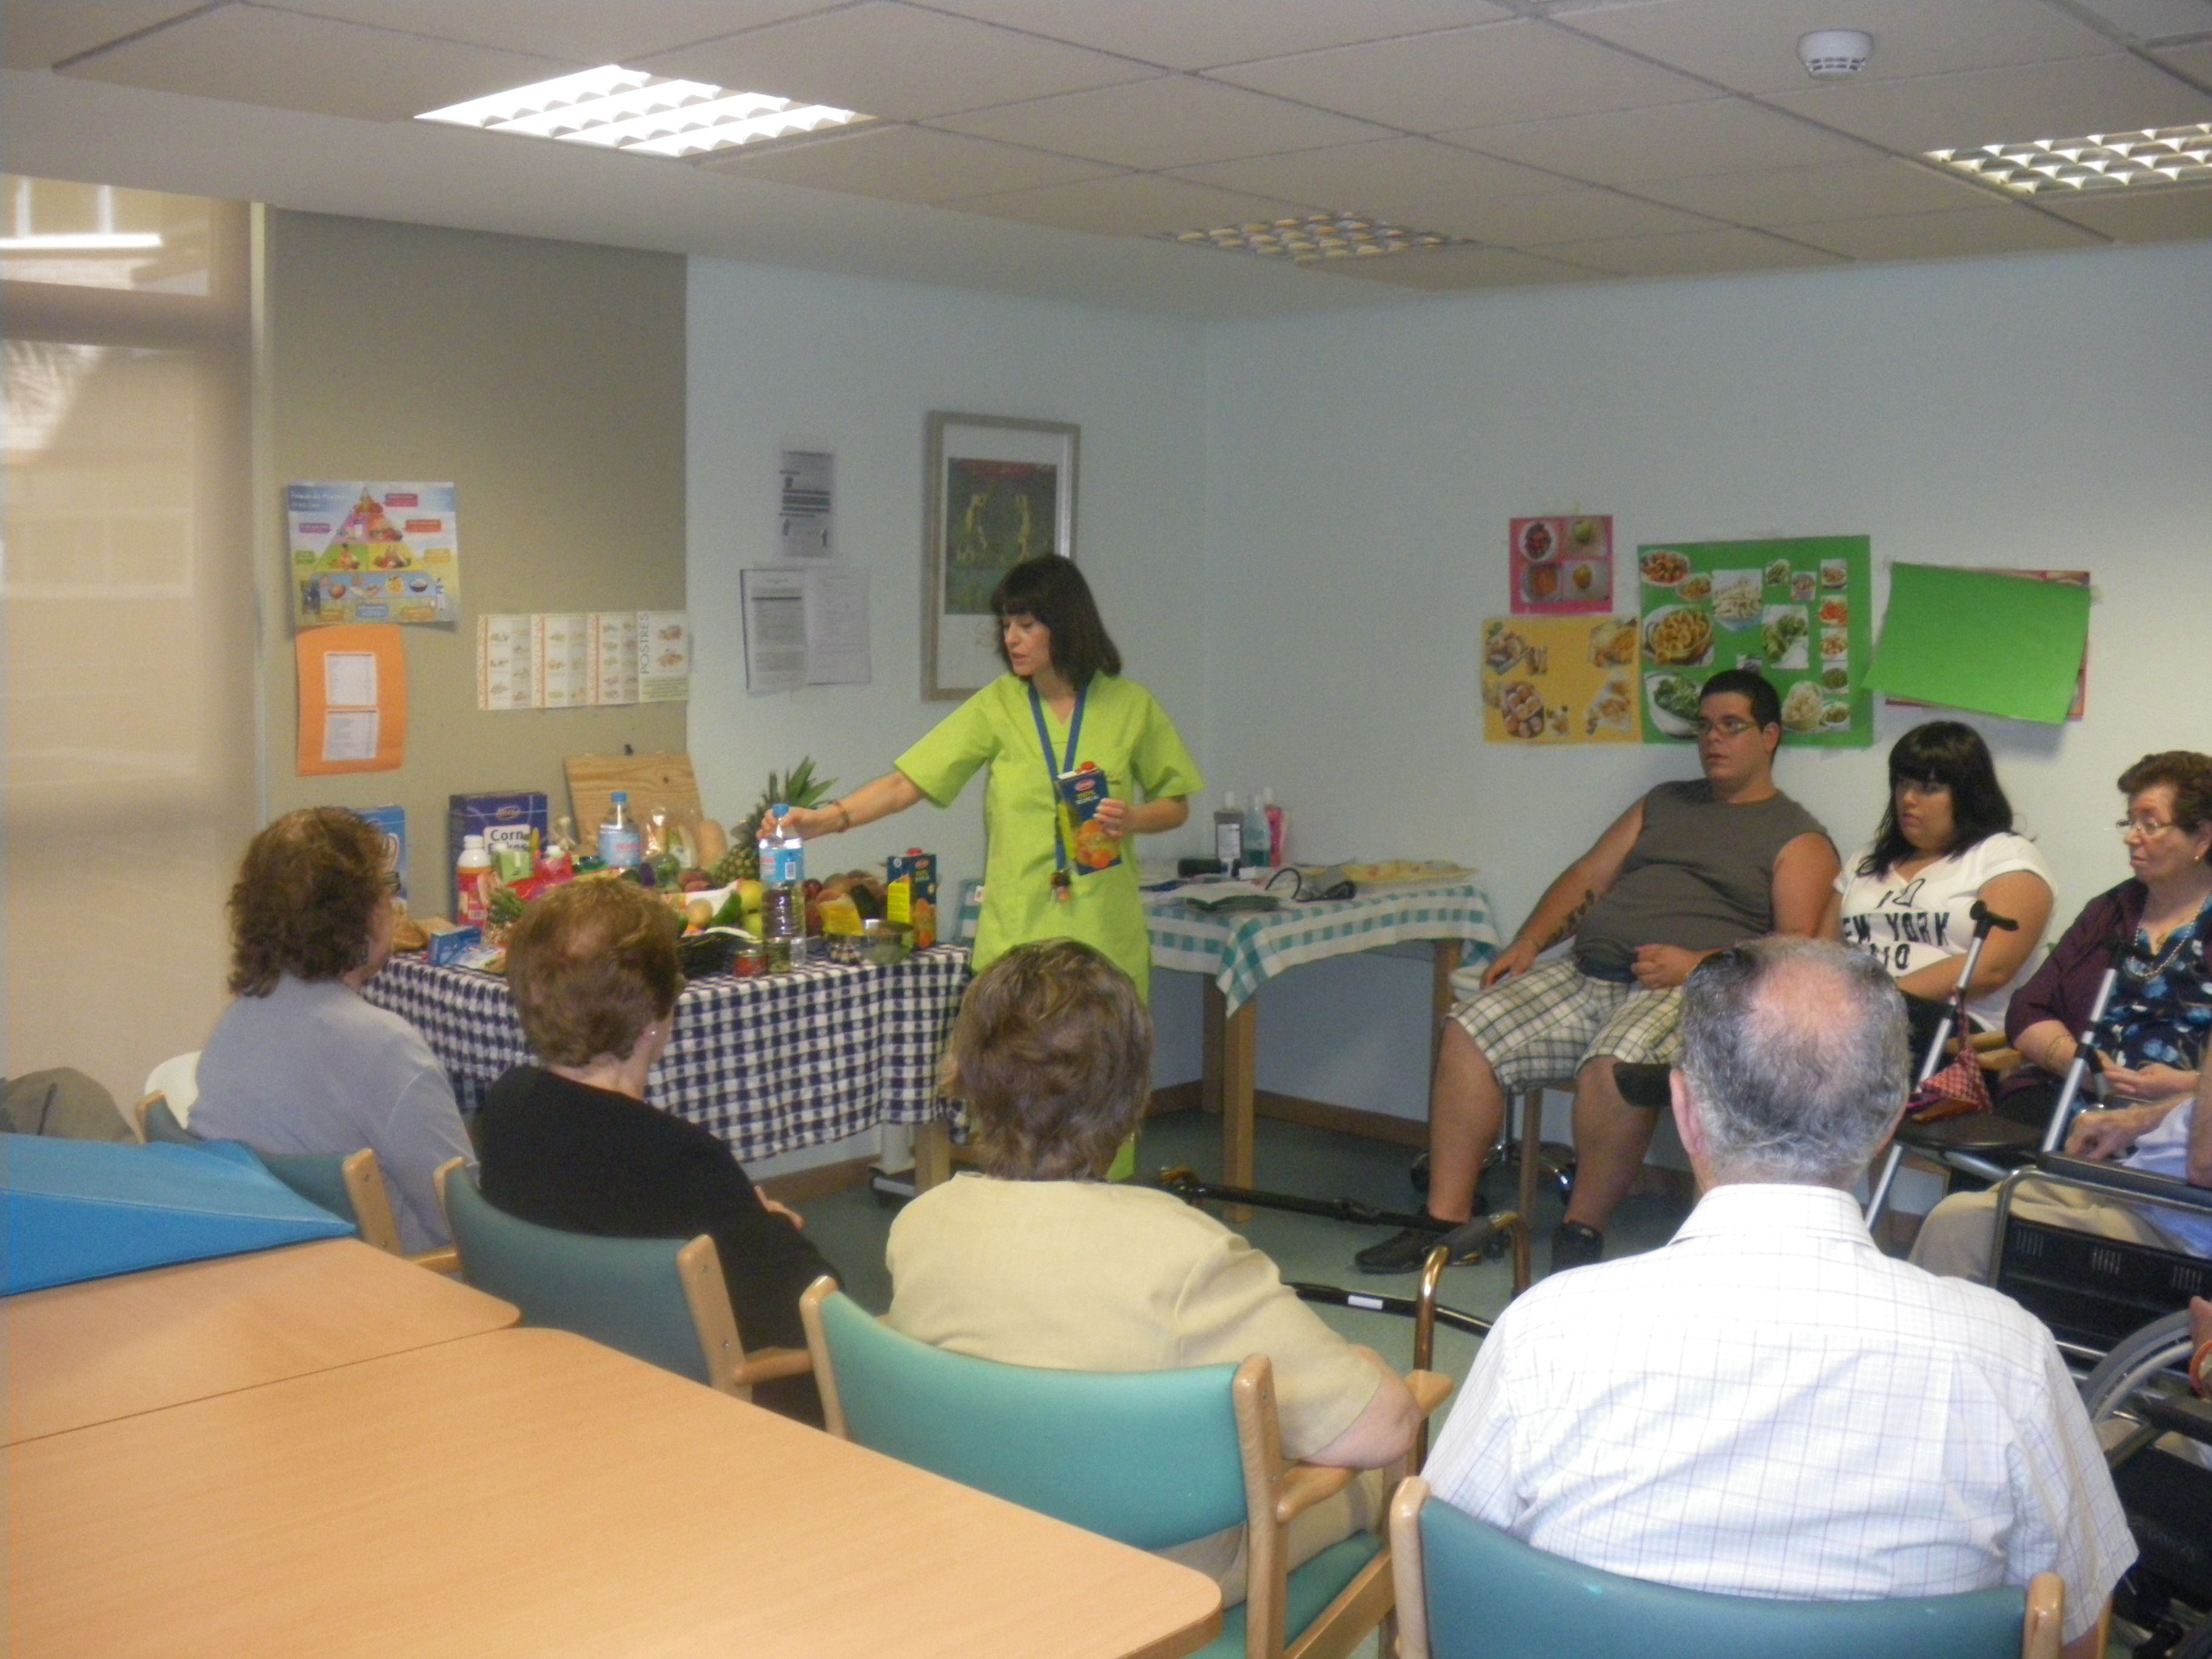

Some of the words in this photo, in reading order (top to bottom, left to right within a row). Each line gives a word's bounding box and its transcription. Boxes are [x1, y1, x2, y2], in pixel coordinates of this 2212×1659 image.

[639, 613, 649, 674] POSTRES
[490, 829, 524, 842] Corn
[1842, 914, 1872, 945] EW
[1885, 911, 1950, 947] YORK
